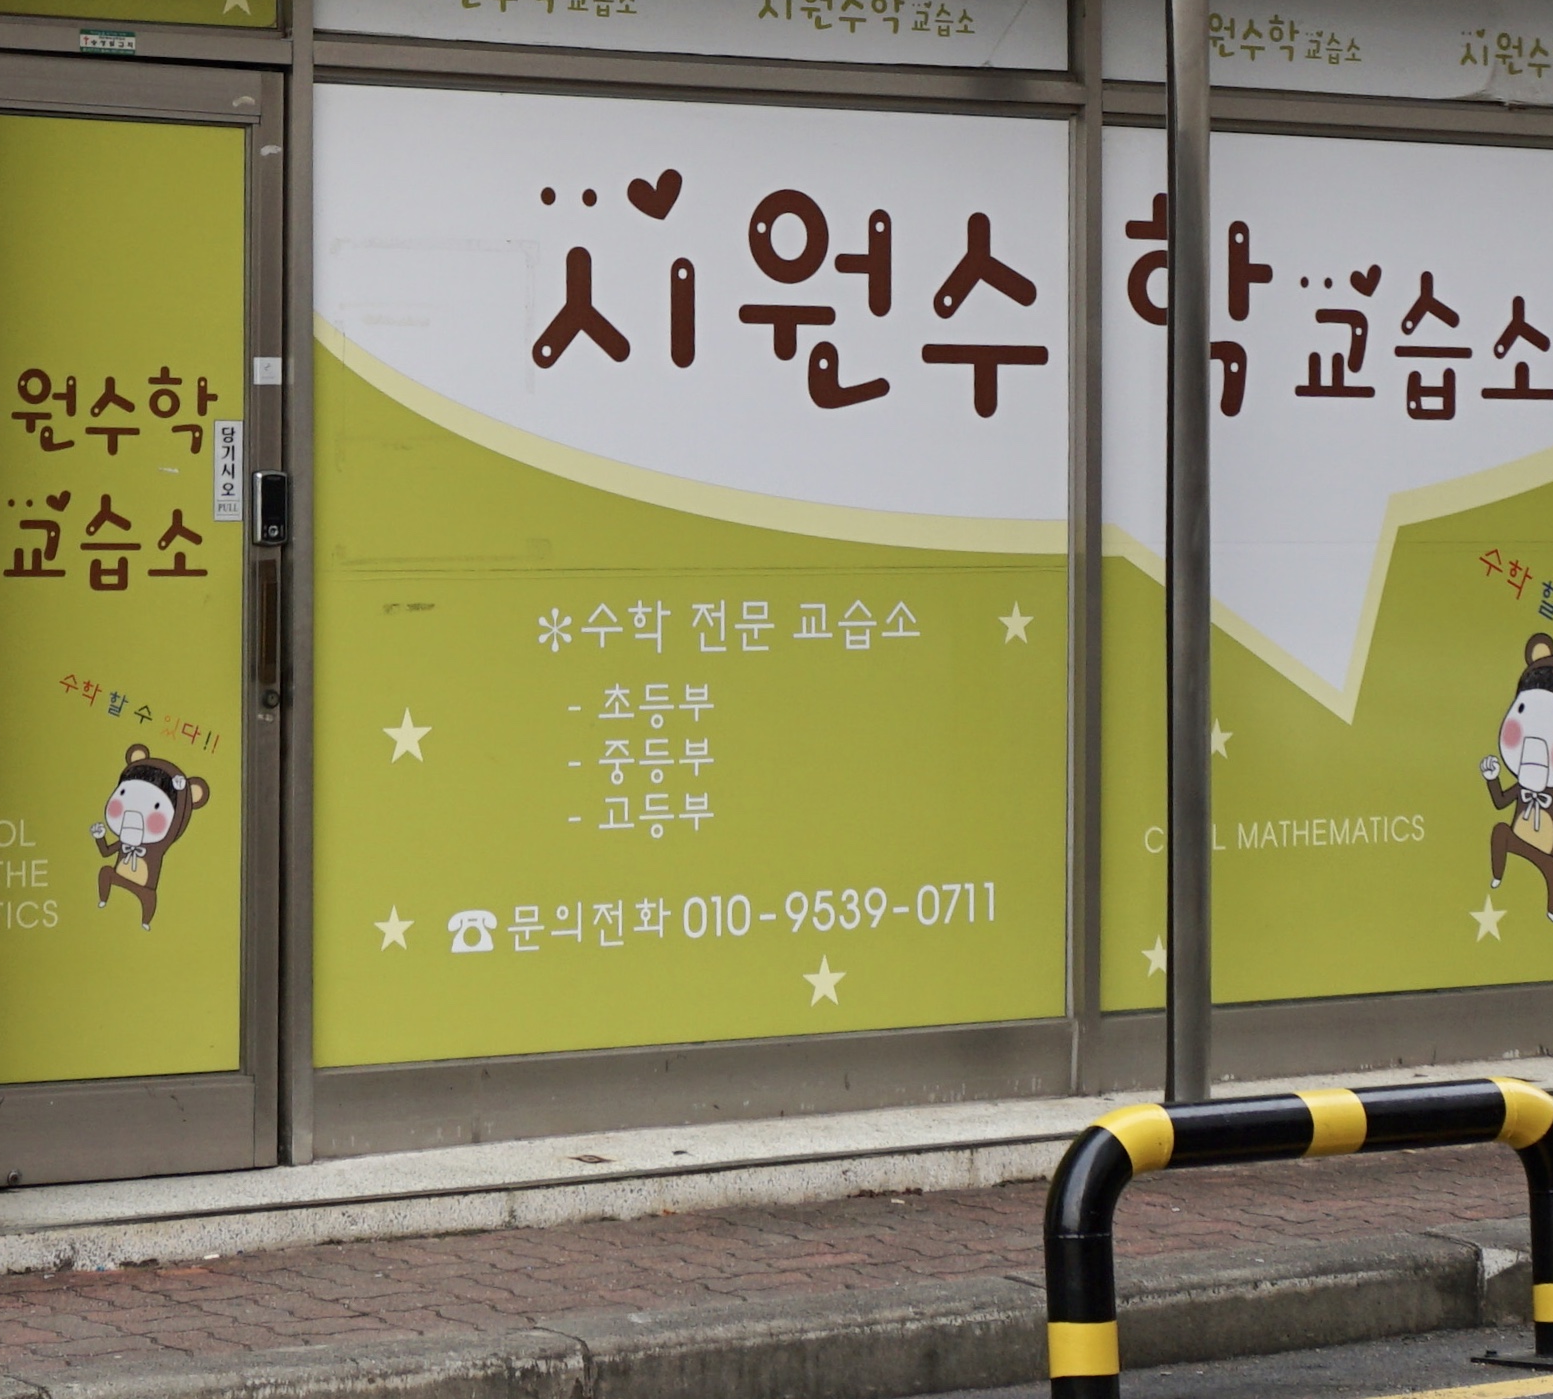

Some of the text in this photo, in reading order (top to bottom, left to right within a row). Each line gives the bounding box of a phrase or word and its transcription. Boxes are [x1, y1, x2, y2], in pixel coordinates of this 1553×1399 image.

[912, 0, 976, 37] 교습소
[1208, 13, 1362, 65] 원수학 교습소
[532, 188, 1273, 419] 시원수학
[220, 426, 236, 497] 당기시오
[217, 502, 239, 513] PULL
[3, 493, 208, 591] 교습소
[1478, 548, 1532, 600] 수학
[581, 600, 921, 653] 수학 전문 교습소
[59, 673, 102, 707] 수학
[107, 690, 129, 717] 할
[134, 704, 153, 724] 수
[598, 682, 715, 729] 초등부
[598, 737, 715, 785] 중등부
[598, 792, 715, 839] 고등부
[1145, 815, 1426, 854] CL MATHEMATICS
[508, 882, 998, 952] 문의전화 010-9539-0711
